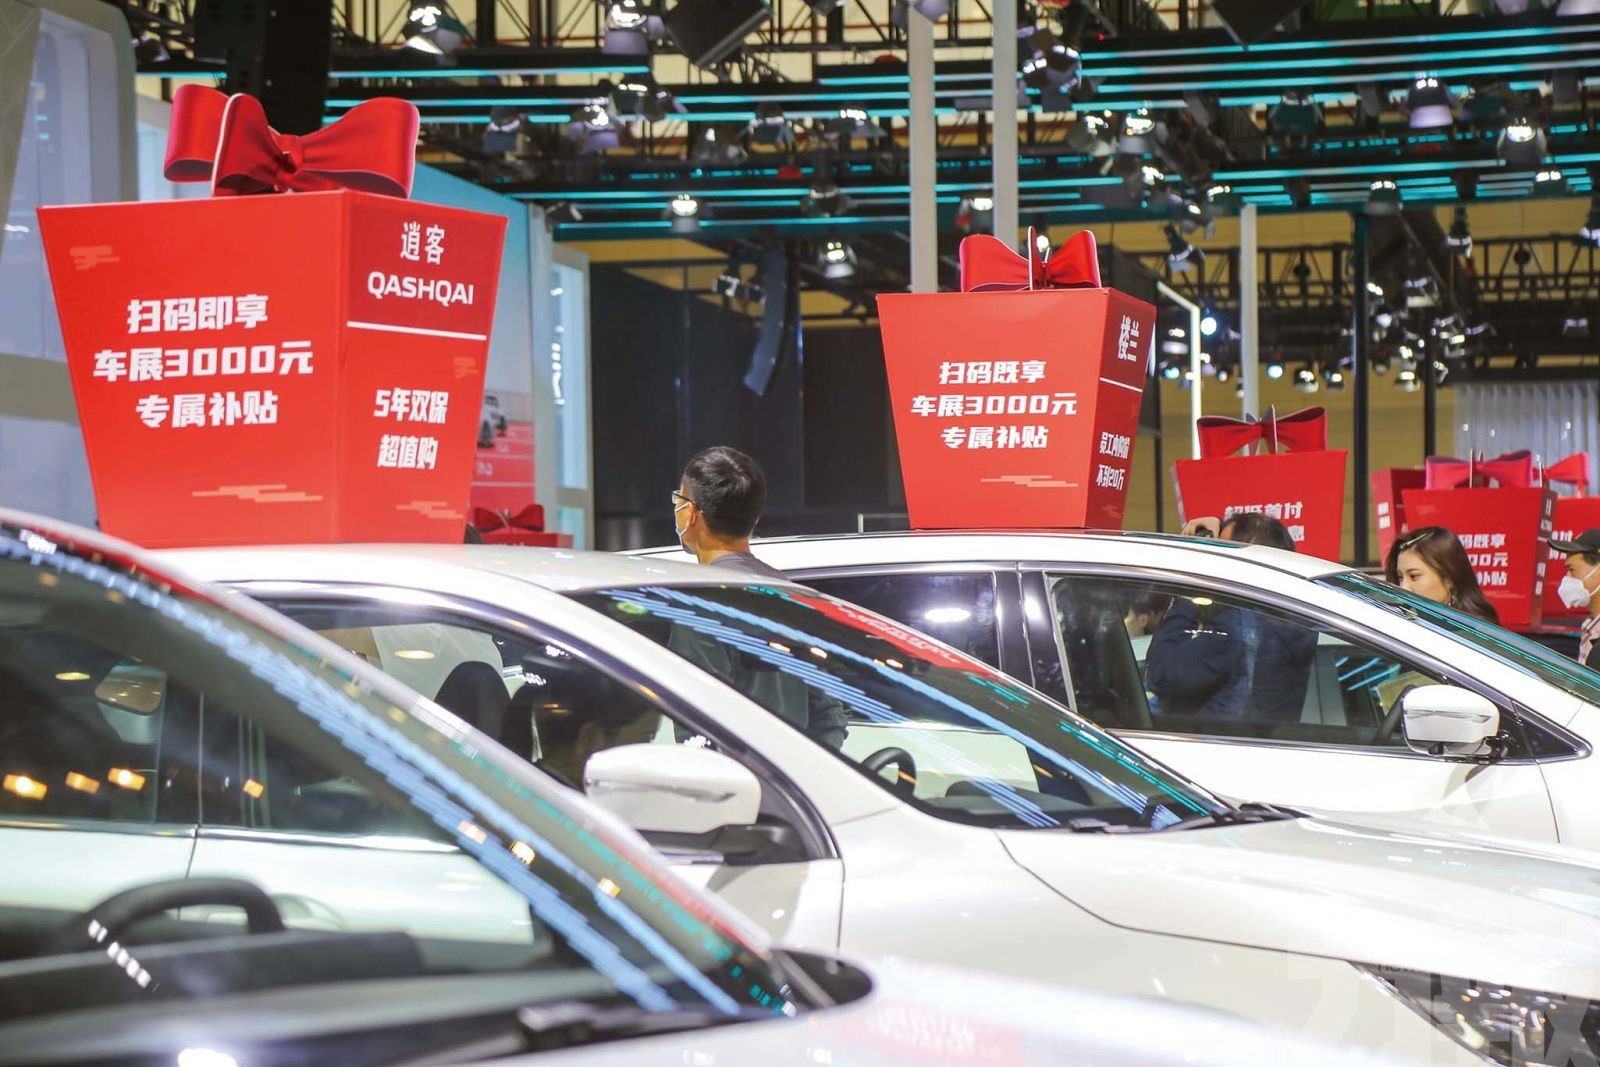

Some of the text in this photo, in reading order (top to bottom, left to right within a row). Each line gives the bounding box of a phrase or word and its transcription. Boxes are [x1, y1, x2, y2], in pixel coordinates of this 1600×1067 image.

[400, 221, 445, 265] 逍客
[367, 271, 474, 307] QASHQAI
[127, 294, 269, 334] 扫码即享
[1117, 314, 1140, 363] 楼兰
[93, 340, 314, 382] 车展3000元
[939, 360, 1047, 385] 扫码既享
[135, 390, 279, 428] 专属补贴
[373, 387, 449, 424] 5年双保
[910, 392, 1078, 417] 车展3000元
[377, 434, 439, 470] 超值购
[940, 425, 1049, 449] 专属补贴
[1095, 464, 1126, 491] 不到20万
[1457, 533, 1507, 549] 码既享
